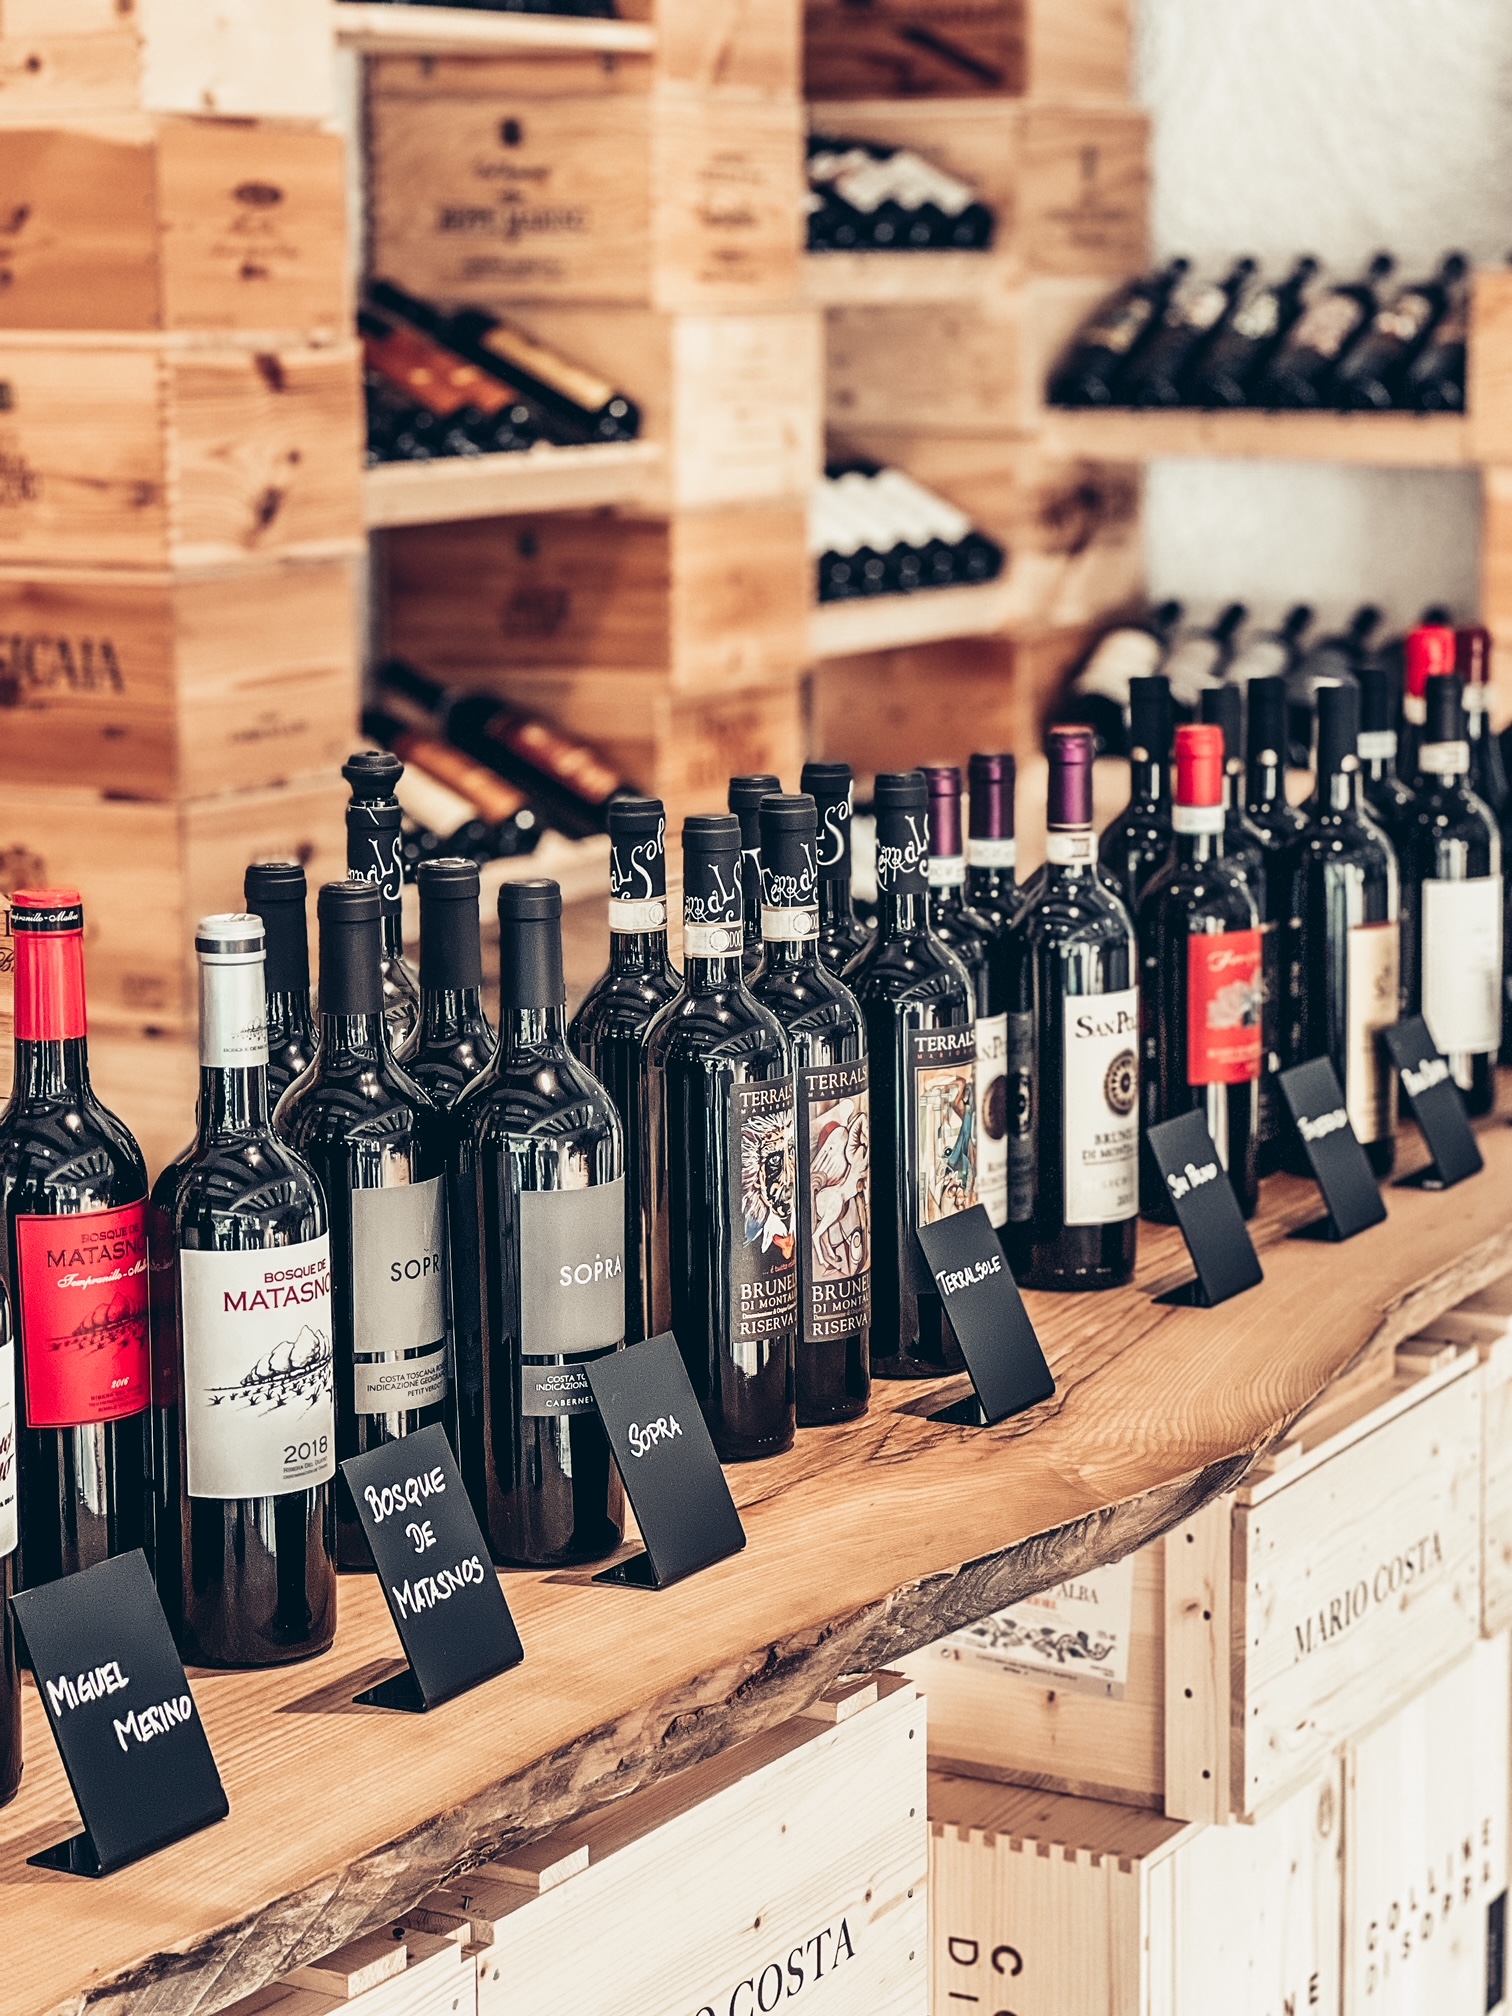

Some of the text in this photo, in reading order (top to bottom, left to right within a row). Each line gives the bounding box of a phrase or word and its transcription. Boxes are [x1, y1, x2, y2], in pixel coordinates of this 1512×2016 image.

[81, 1222, 140, 1243] BOSQUE DE
[264, 1258, 327, 1283] BOSQUE DE
[741, 1300, 755, 1312] DI
[813, 1303, 827, 1314] DI
[740, 1312, 794, 1335] RISERVA
[812, 1312, 868, 1336] RISERVA
[367, 1379, 419, 1393] INDICAZIONE
[379, 1373, 406, 1384] COSTA
[406, 1366, 436, 1381] TOSCANA
[547, 1375, 575, 1384] COSTA
[407, 1387, 424, 1397] PETIT
[628, 1414, 683, 1458] SOPRA
[283, 1435, 328, 1464] 2018
[364, 1466, 446, 1524] BOSQUE
[405, 1520, 437, 1554] DE
[391, 1555, 485, 1619] MATASNOS
[1295, 1530, 1443, 1663] MARIO COSTA
[46, 1661, 130, 1718] MIGUEL
[112, 1695, 192, 1752] MERINO
[729, 1917, 856, 2016] COSTA
